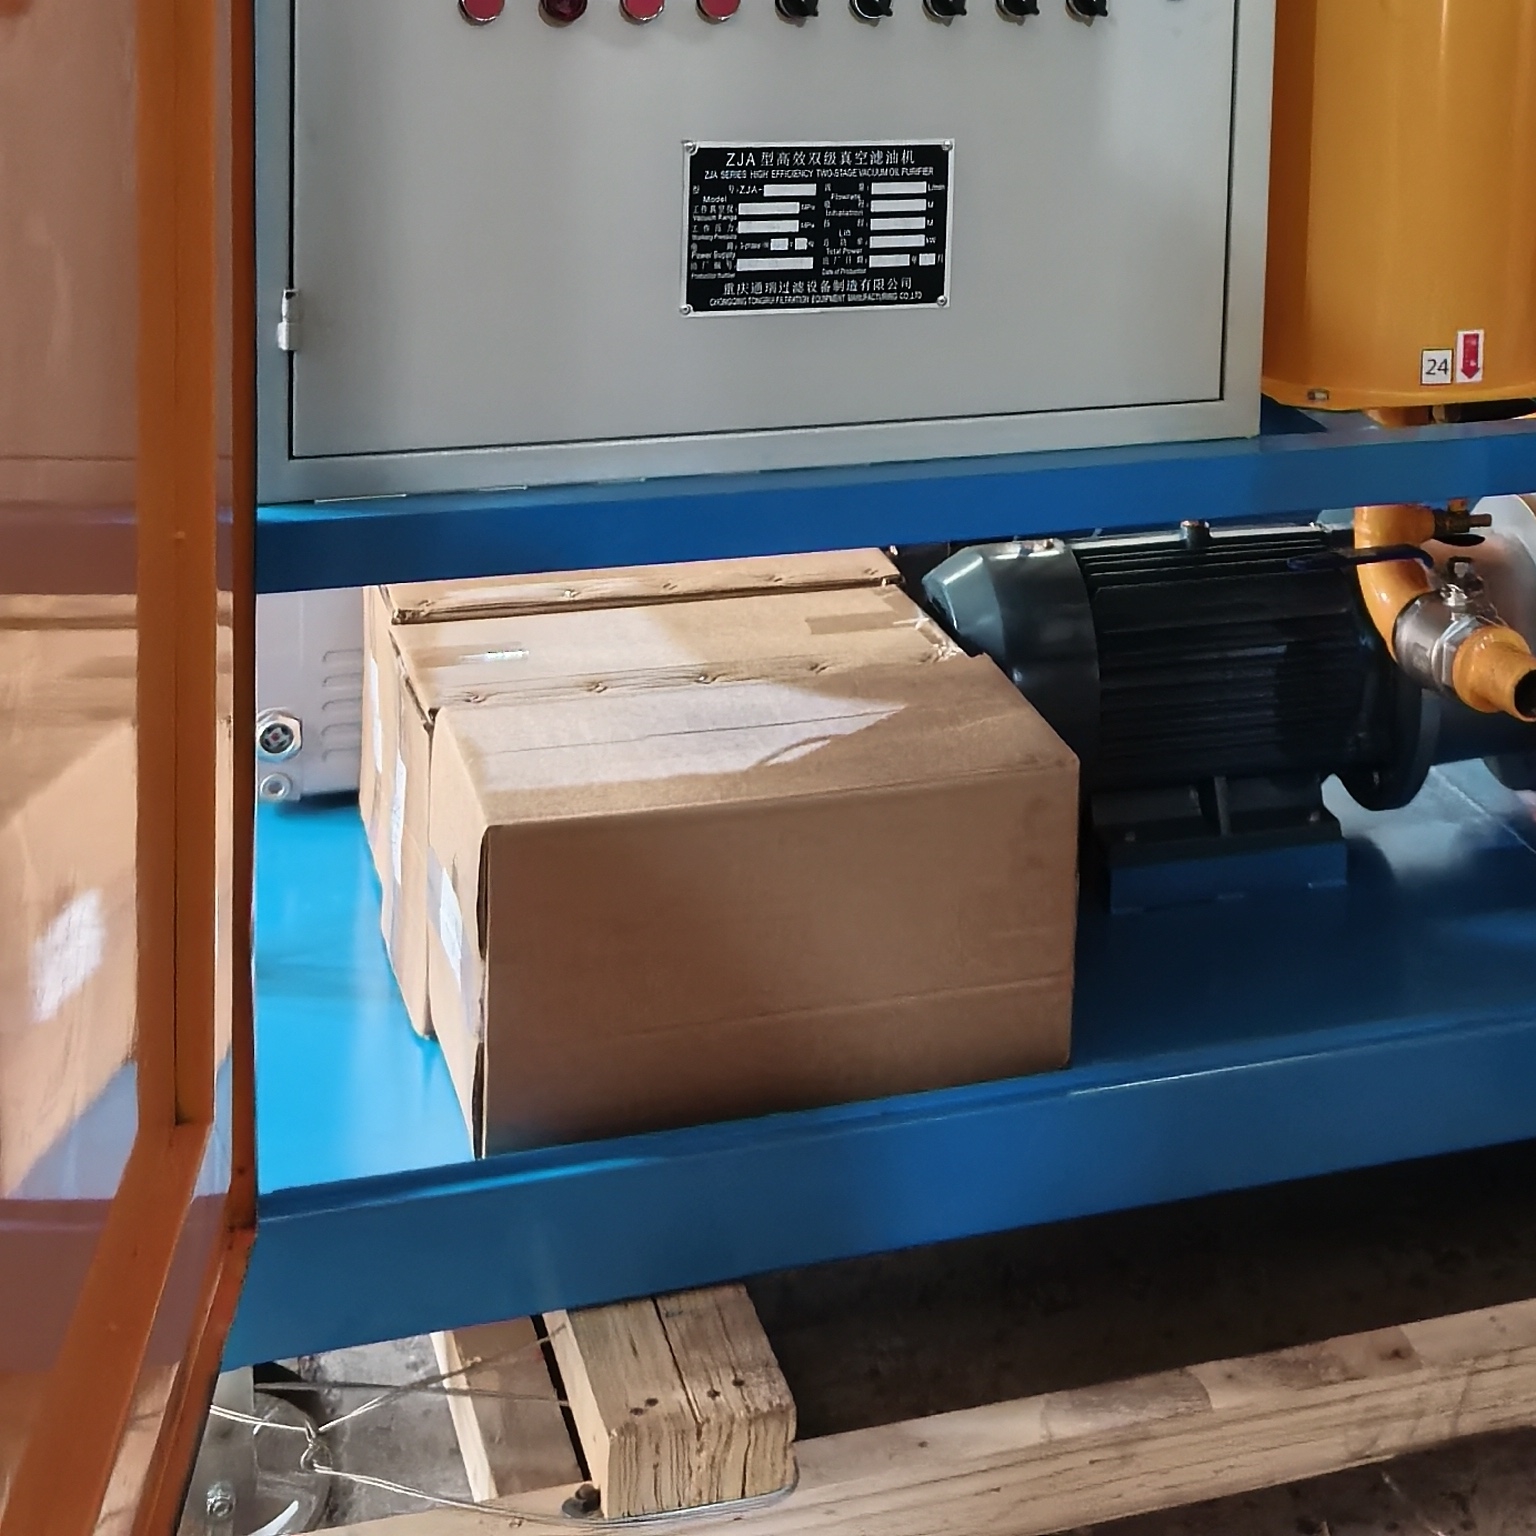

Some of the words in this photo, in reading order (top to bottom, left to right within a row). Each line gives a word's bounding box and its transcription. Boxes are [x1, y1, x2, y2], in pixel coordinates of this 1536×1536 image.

[771, 168, 814, 179] EFFICIENCY
[859, 166, 888, 177] VACUUM
[702, 195, 727, 203] Model
[1425, 358, 1449, 376] 24
